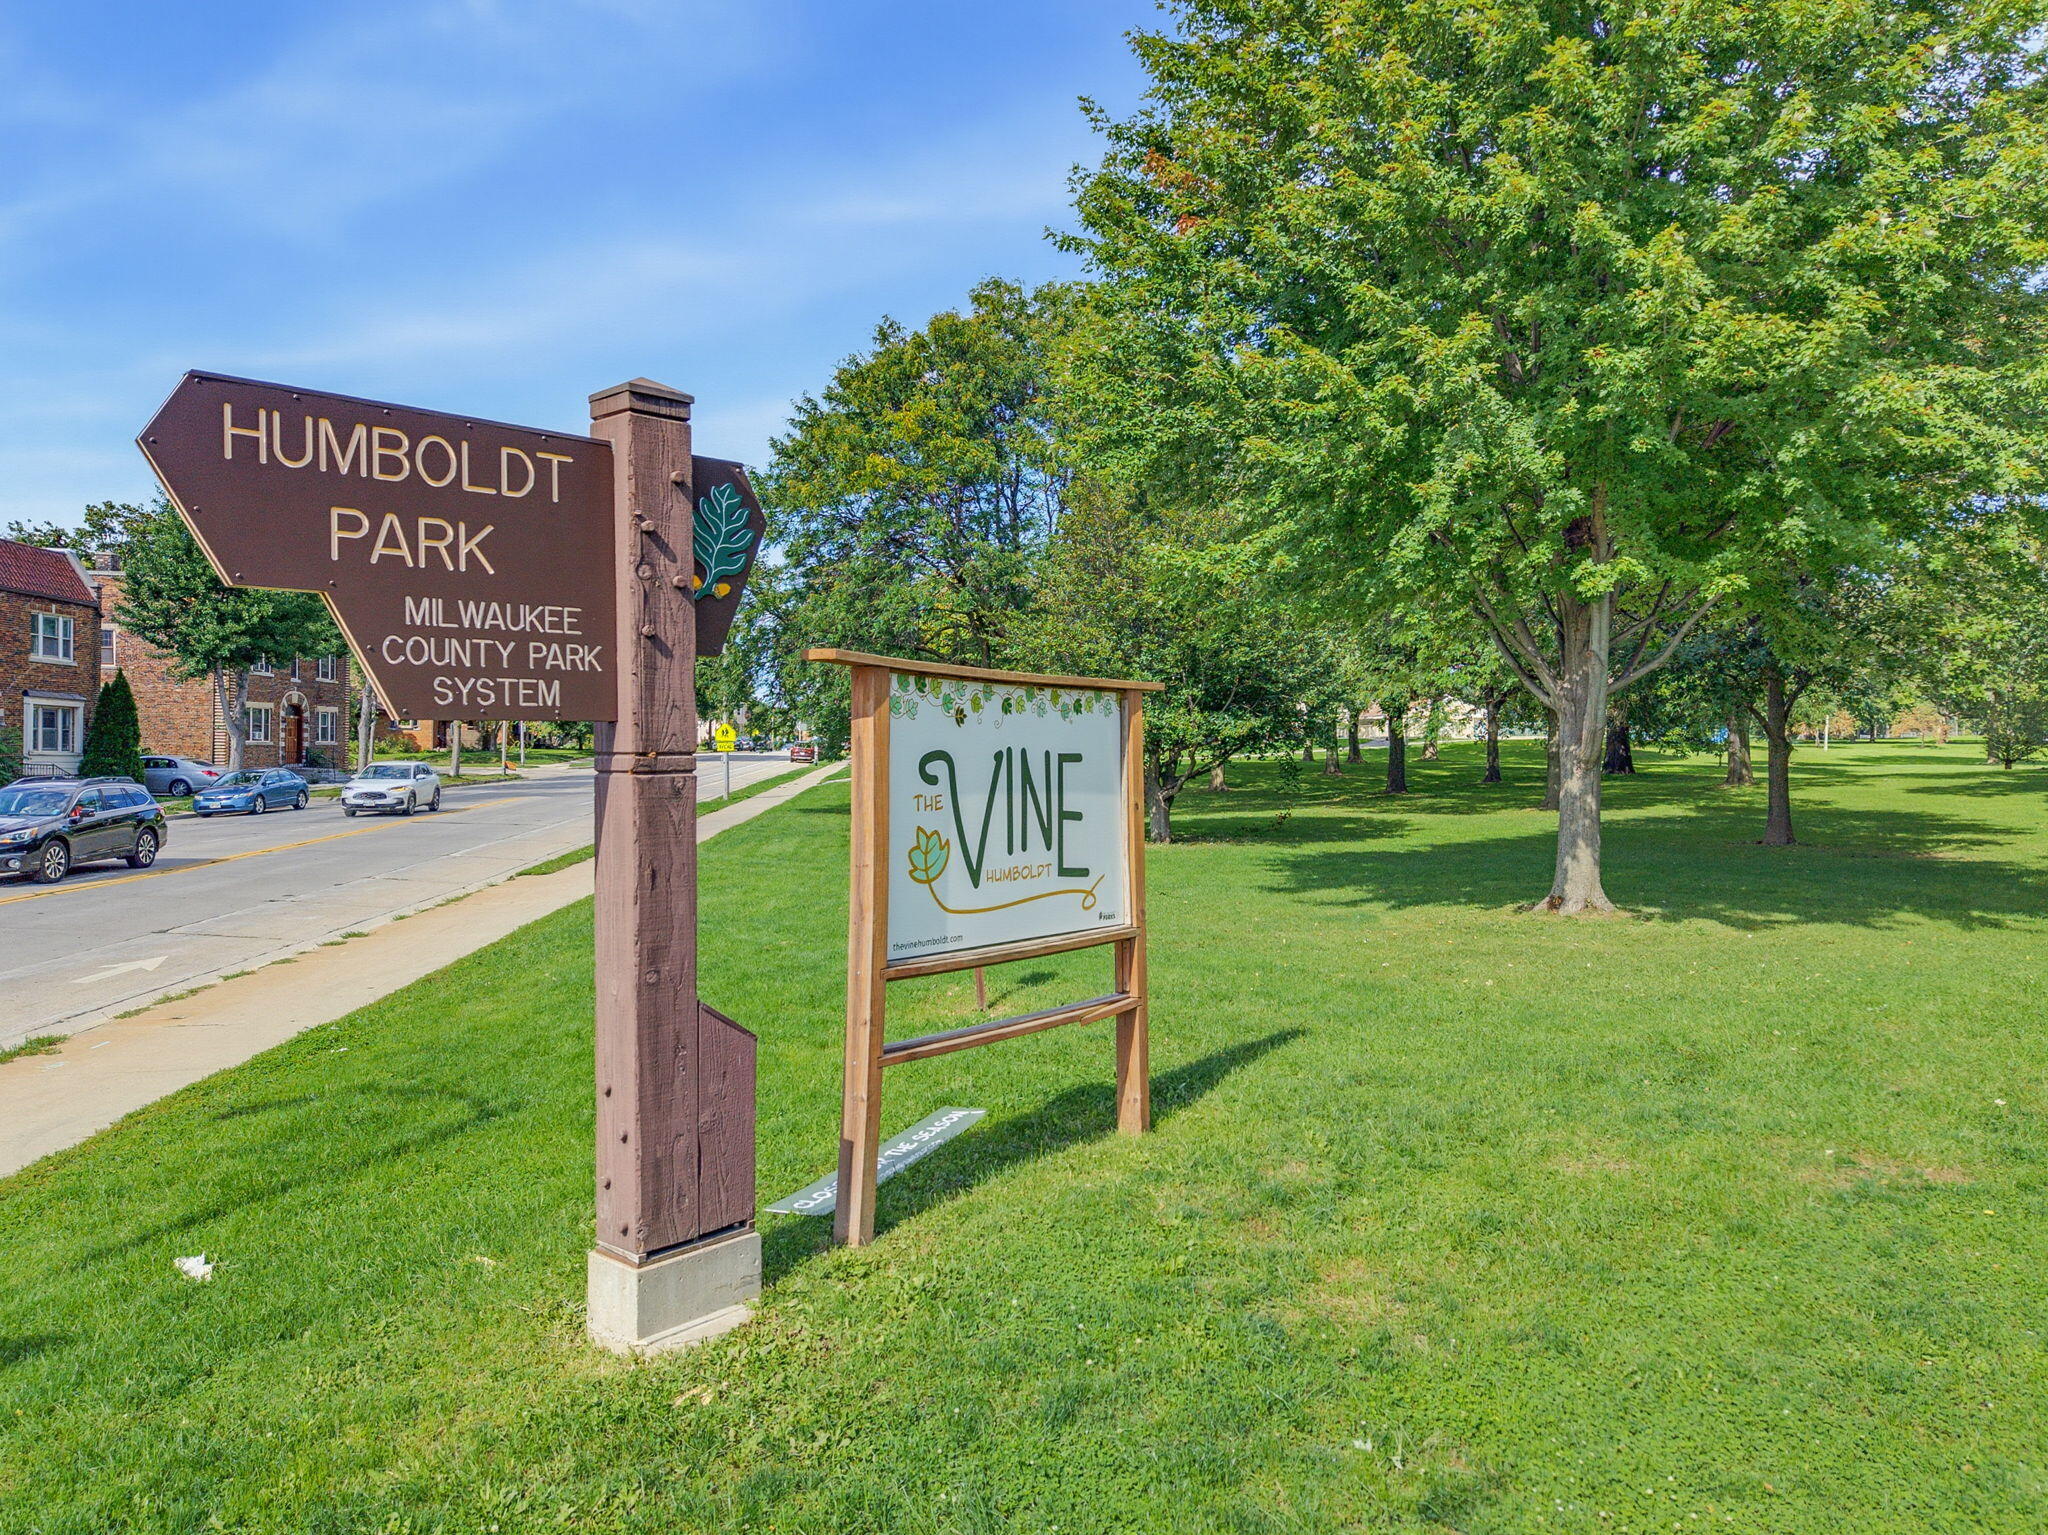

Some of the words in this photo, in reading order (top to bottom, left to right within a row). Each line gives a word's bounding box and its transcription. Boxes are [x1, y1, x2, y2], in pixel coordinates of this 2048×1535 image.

[222, 402, 574, 503] HUMBOLDT
[330, 506, 495, 575] PARK
[404, 596, 582, 635] MILWAUKEE
[382, 635, 517, 669] COUNTY
[529, 641, 603, 672] PARK
[433, 676, 561, 708] SYSTEM
[913, 794, 944, 812] THE
[918, 746, 1090, 889] VINE
[986, 864, 1052, 883] HUMBOLDT
[893, 935, 963, 951] thevinehumboldt.com
[793, 1181, 838, 1209] CLOS
[884, 1141, 918, 1156] THE
[912, 1110, 969, 1141] SEASON
